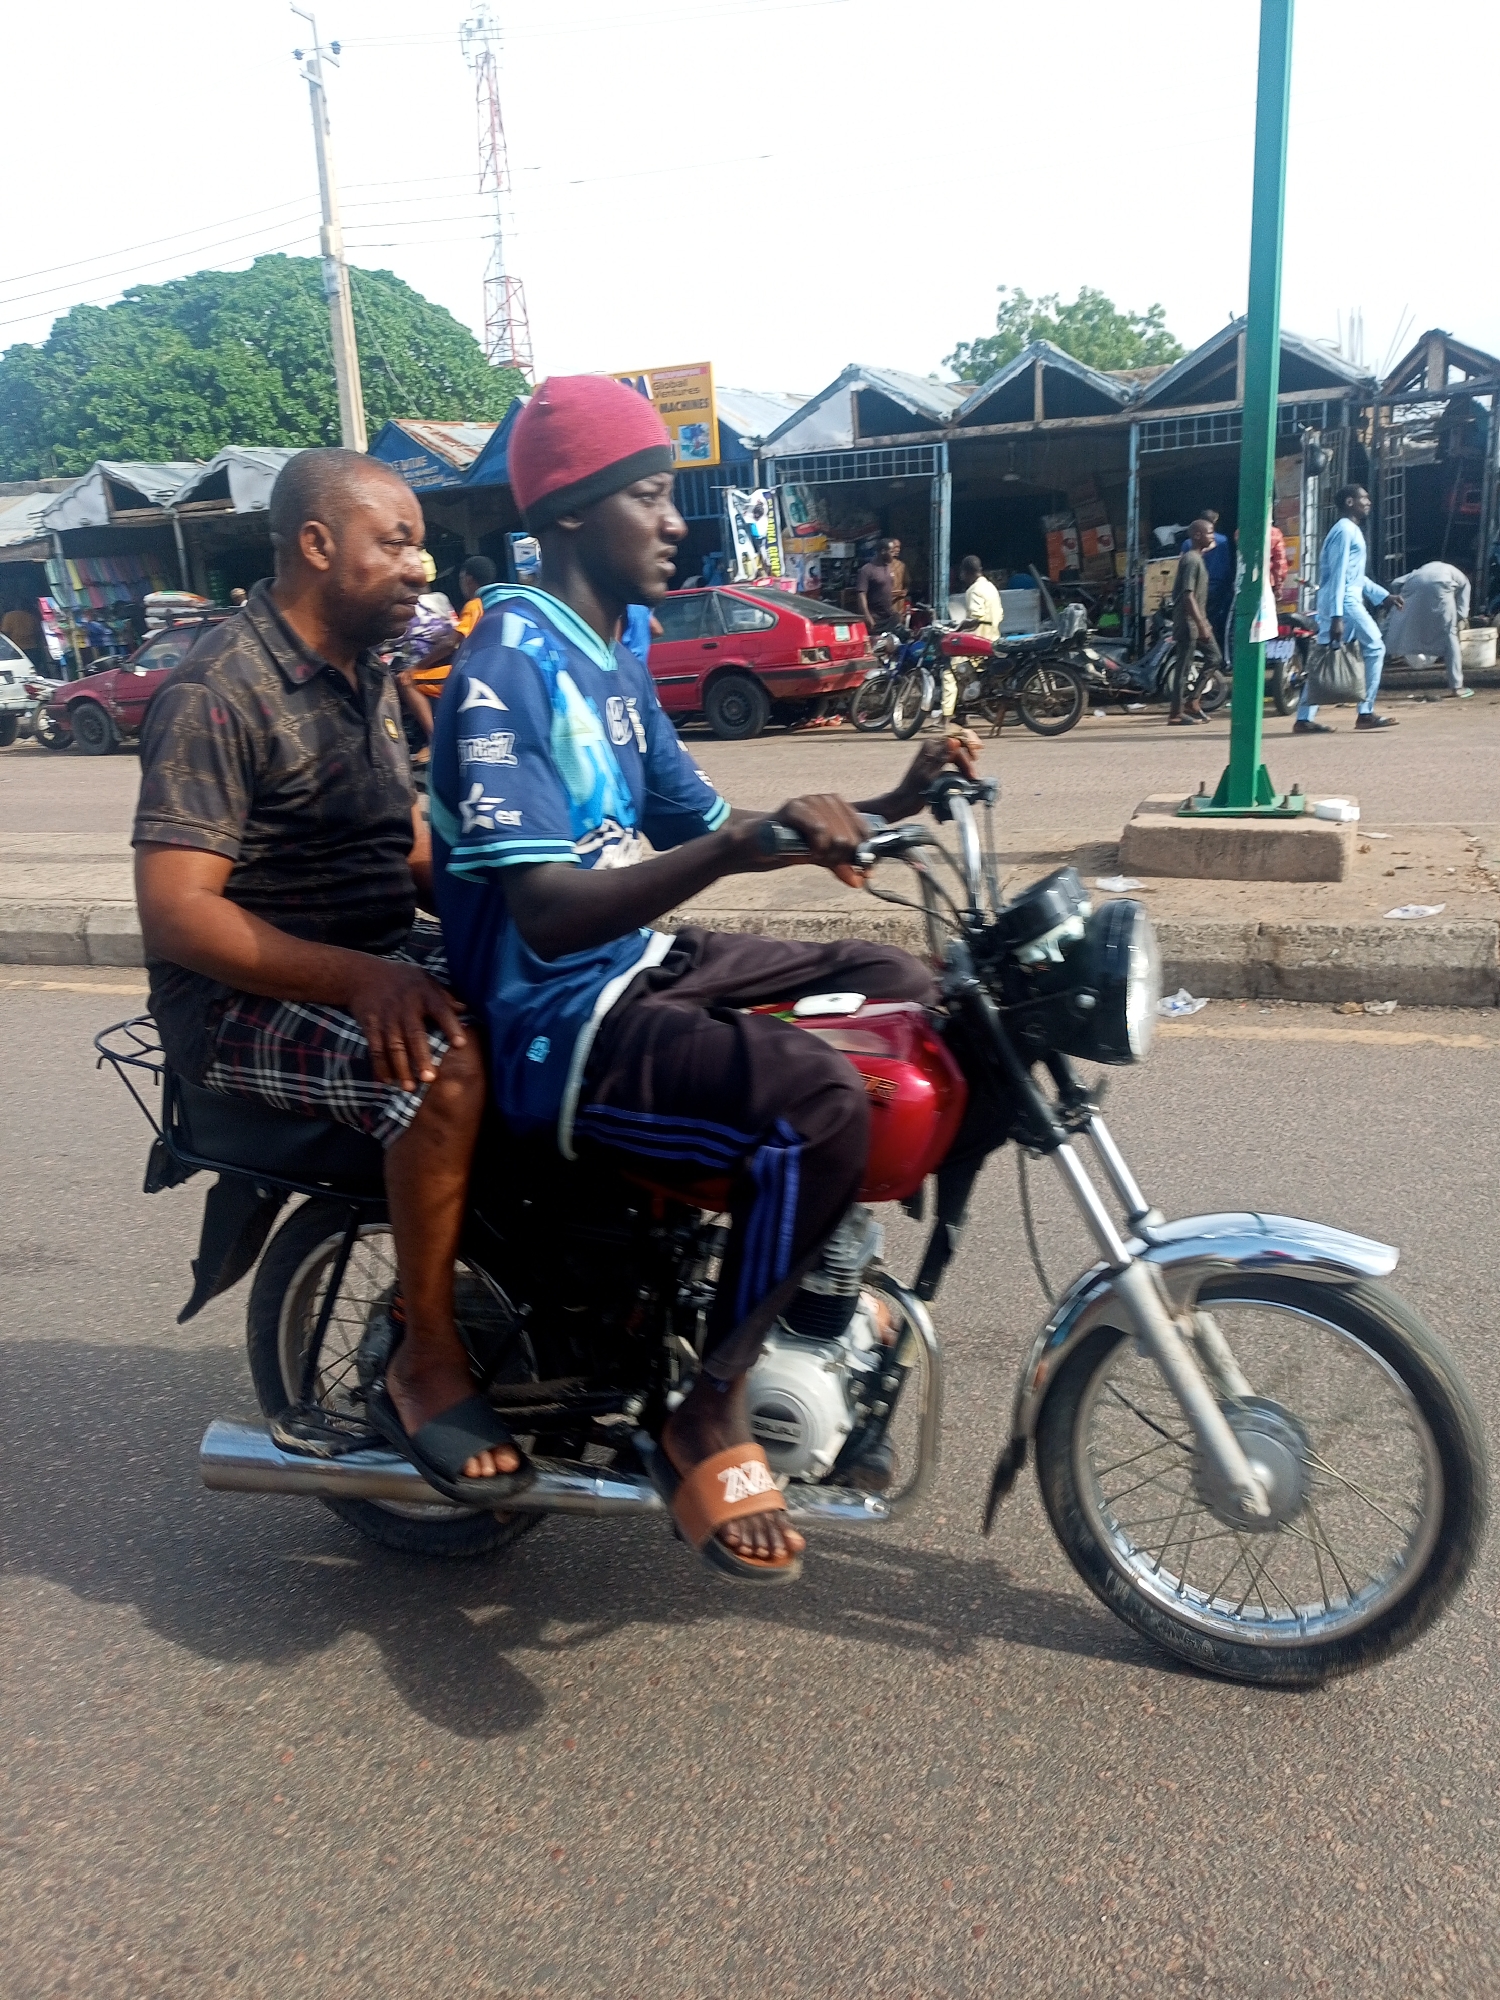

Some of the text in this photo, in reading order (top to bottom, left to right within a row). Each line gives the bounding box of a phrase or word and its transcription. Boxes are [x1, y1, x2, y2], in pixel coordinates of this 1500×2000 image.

[652, 379, 688, 391] Global
[653, 387, 700, 399] Ventures
[659, 398, 710, 413] MACHINES
